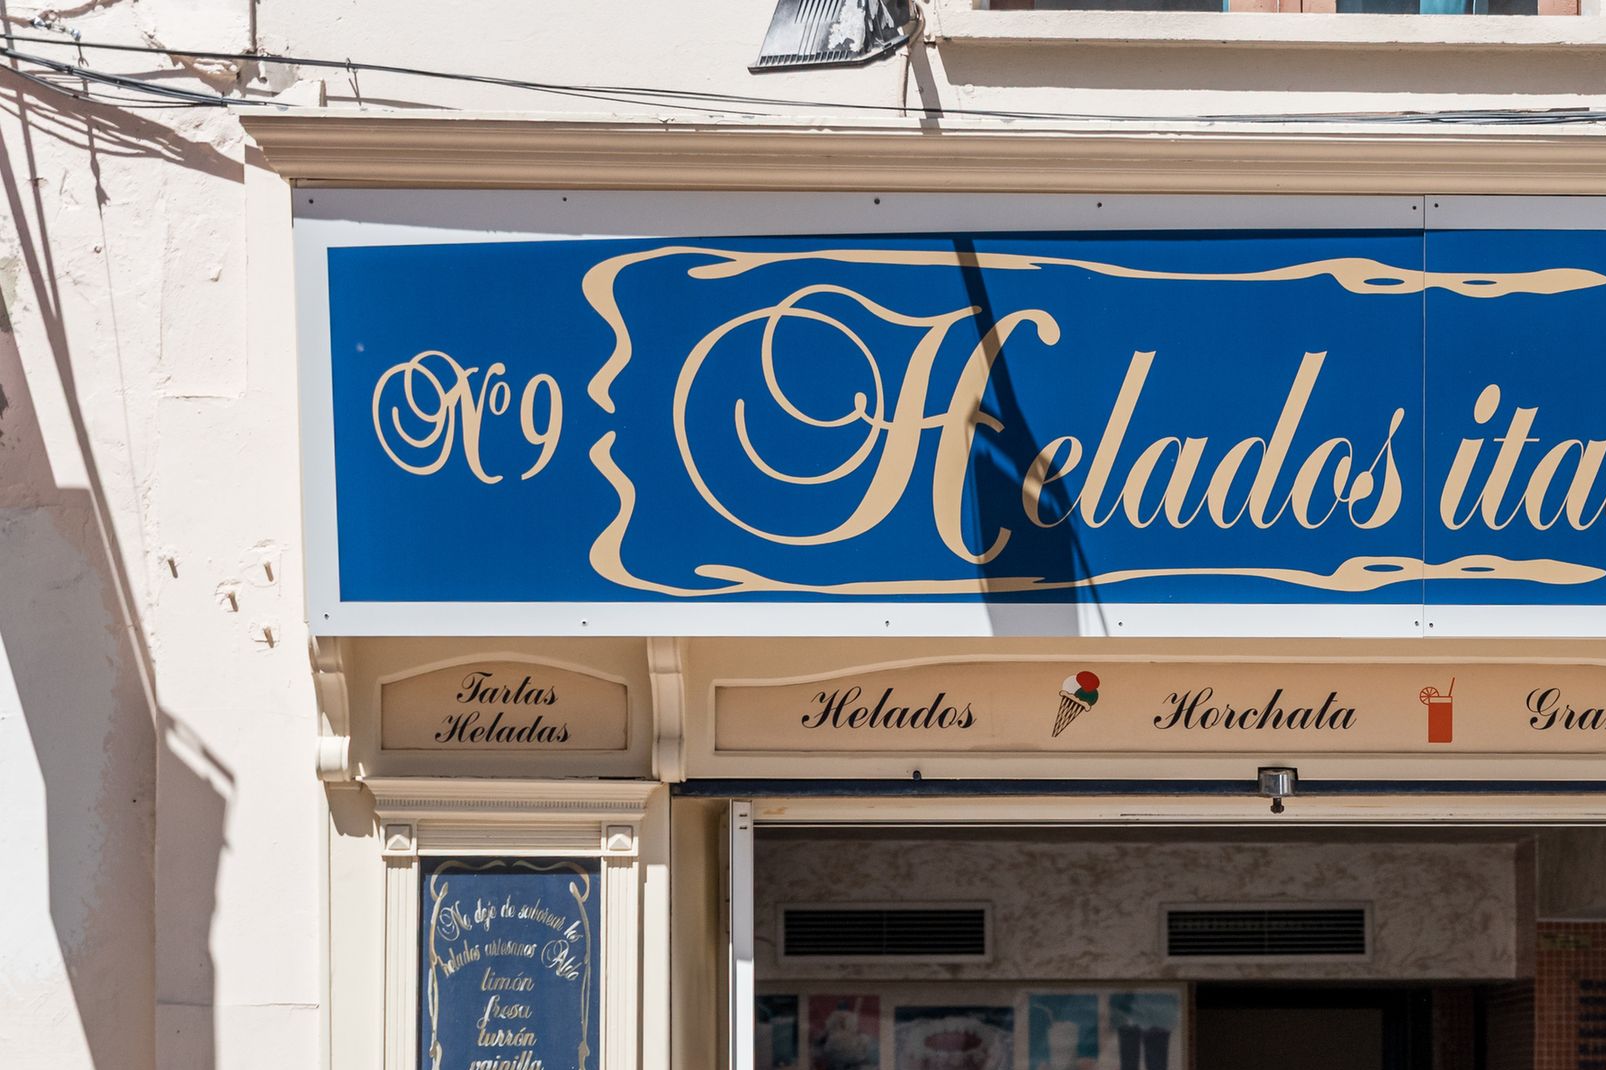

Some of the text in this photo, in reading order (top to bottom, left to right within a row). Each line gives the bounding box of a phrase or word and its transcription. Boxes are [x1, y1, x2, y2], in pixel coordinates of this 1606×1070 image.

[520, 373, 563, 480] 9
[673, 284, 1405, 564] Helados
[456, 671, 559, 706] Tartas
[801, 686, 977, 731] Helados
[1153, 687, 1356, 731] Horchata
[434, 711, 571, 743] Heladas
[437, 901, 473, 941] No
[501, 895, 515, 918] de
[481, 967, 535, 992] limón
[541, 939, 582, 981] Aldo
[477, 995, 532, 1029] fresa
[477, 1027, 538, 1047] turrón
